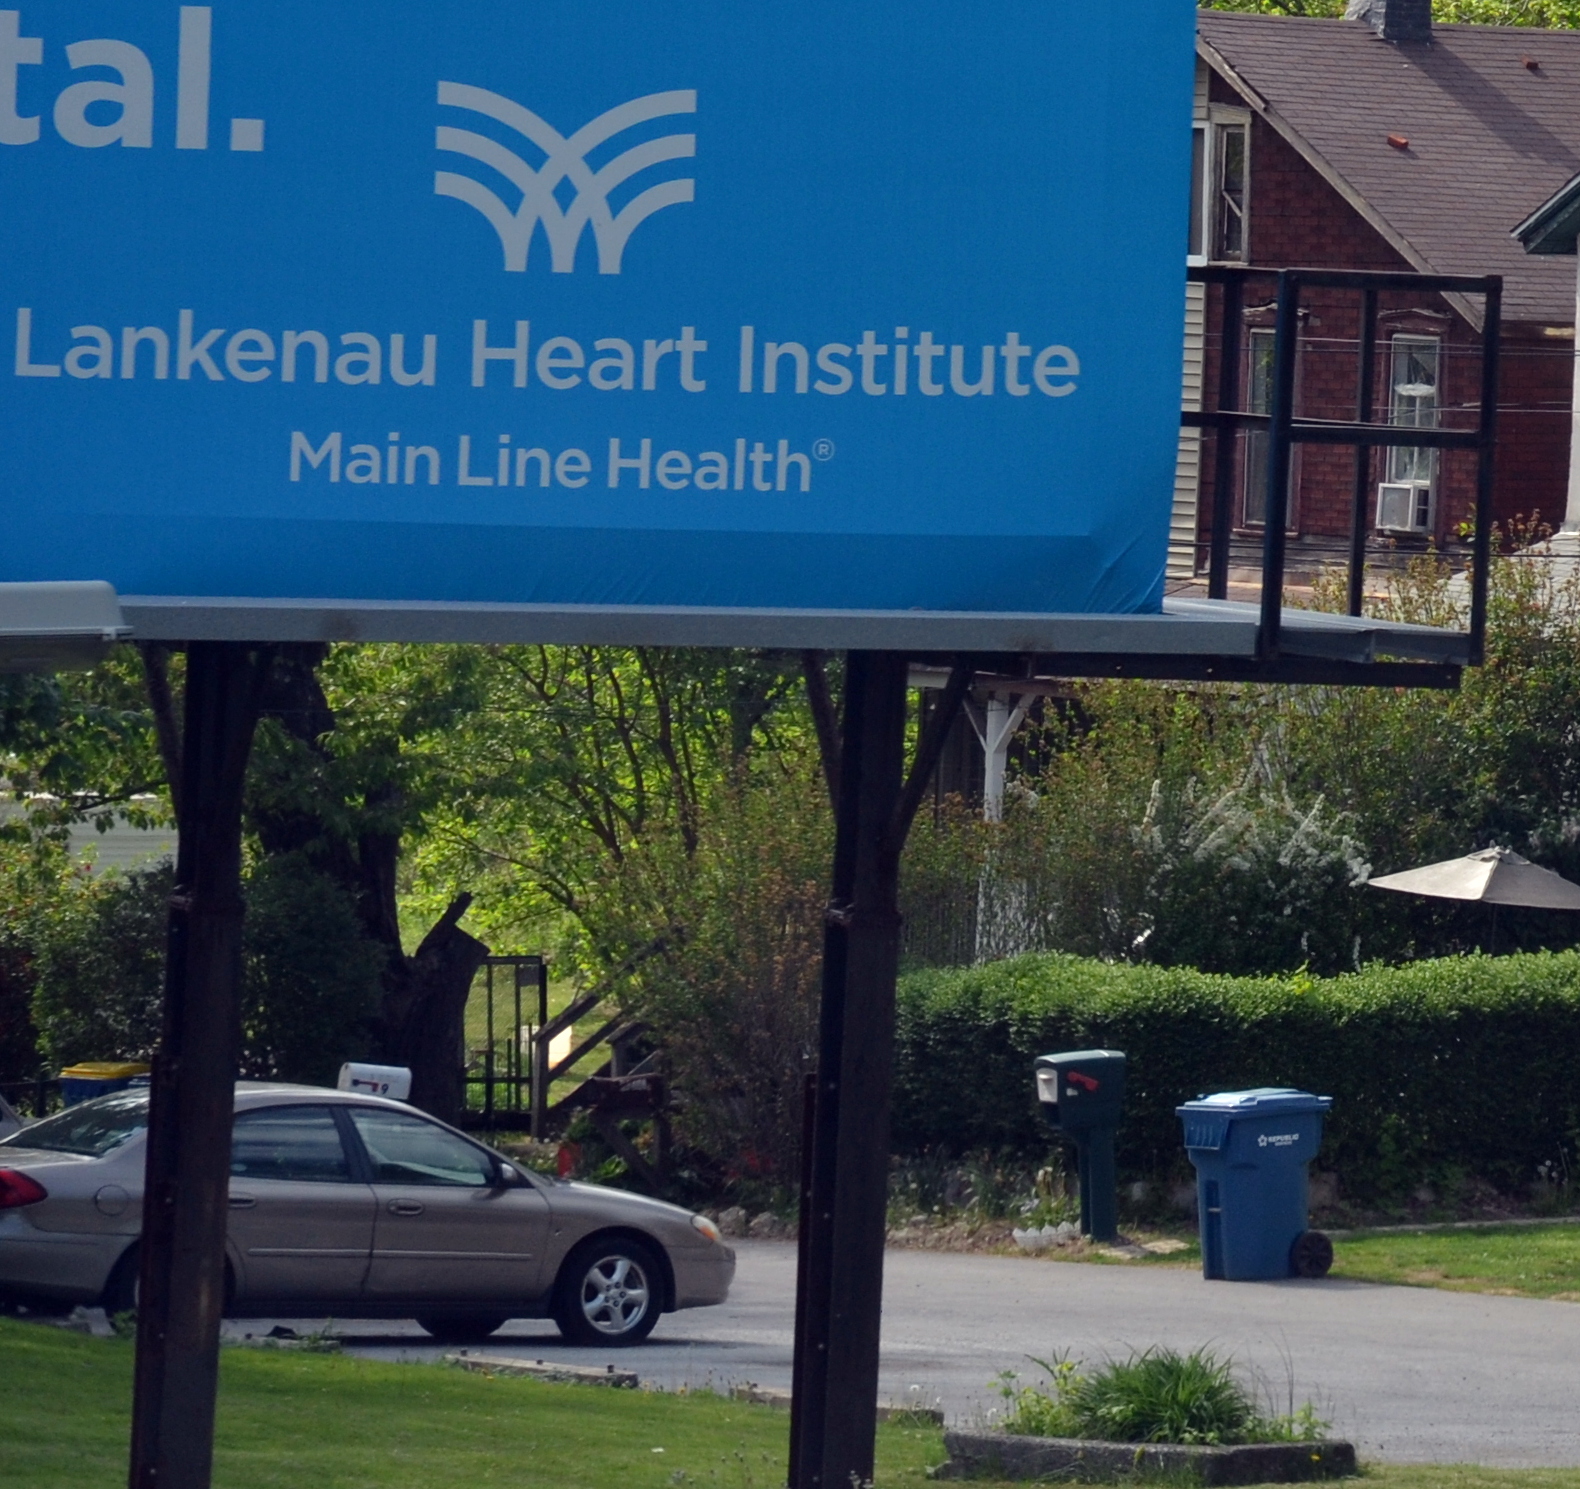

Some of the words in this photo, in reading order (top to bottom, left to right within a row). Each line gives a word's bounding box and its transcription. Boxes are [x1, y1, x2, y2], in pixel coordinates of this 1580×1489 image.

[15, 307, 437, 387] Lankenau
[472, 319, 708, 393] Heart
[739, 325, 1080, 397] Institute
[290, 431, 440, 485] Main
[458, 434, 592, 489] Line
